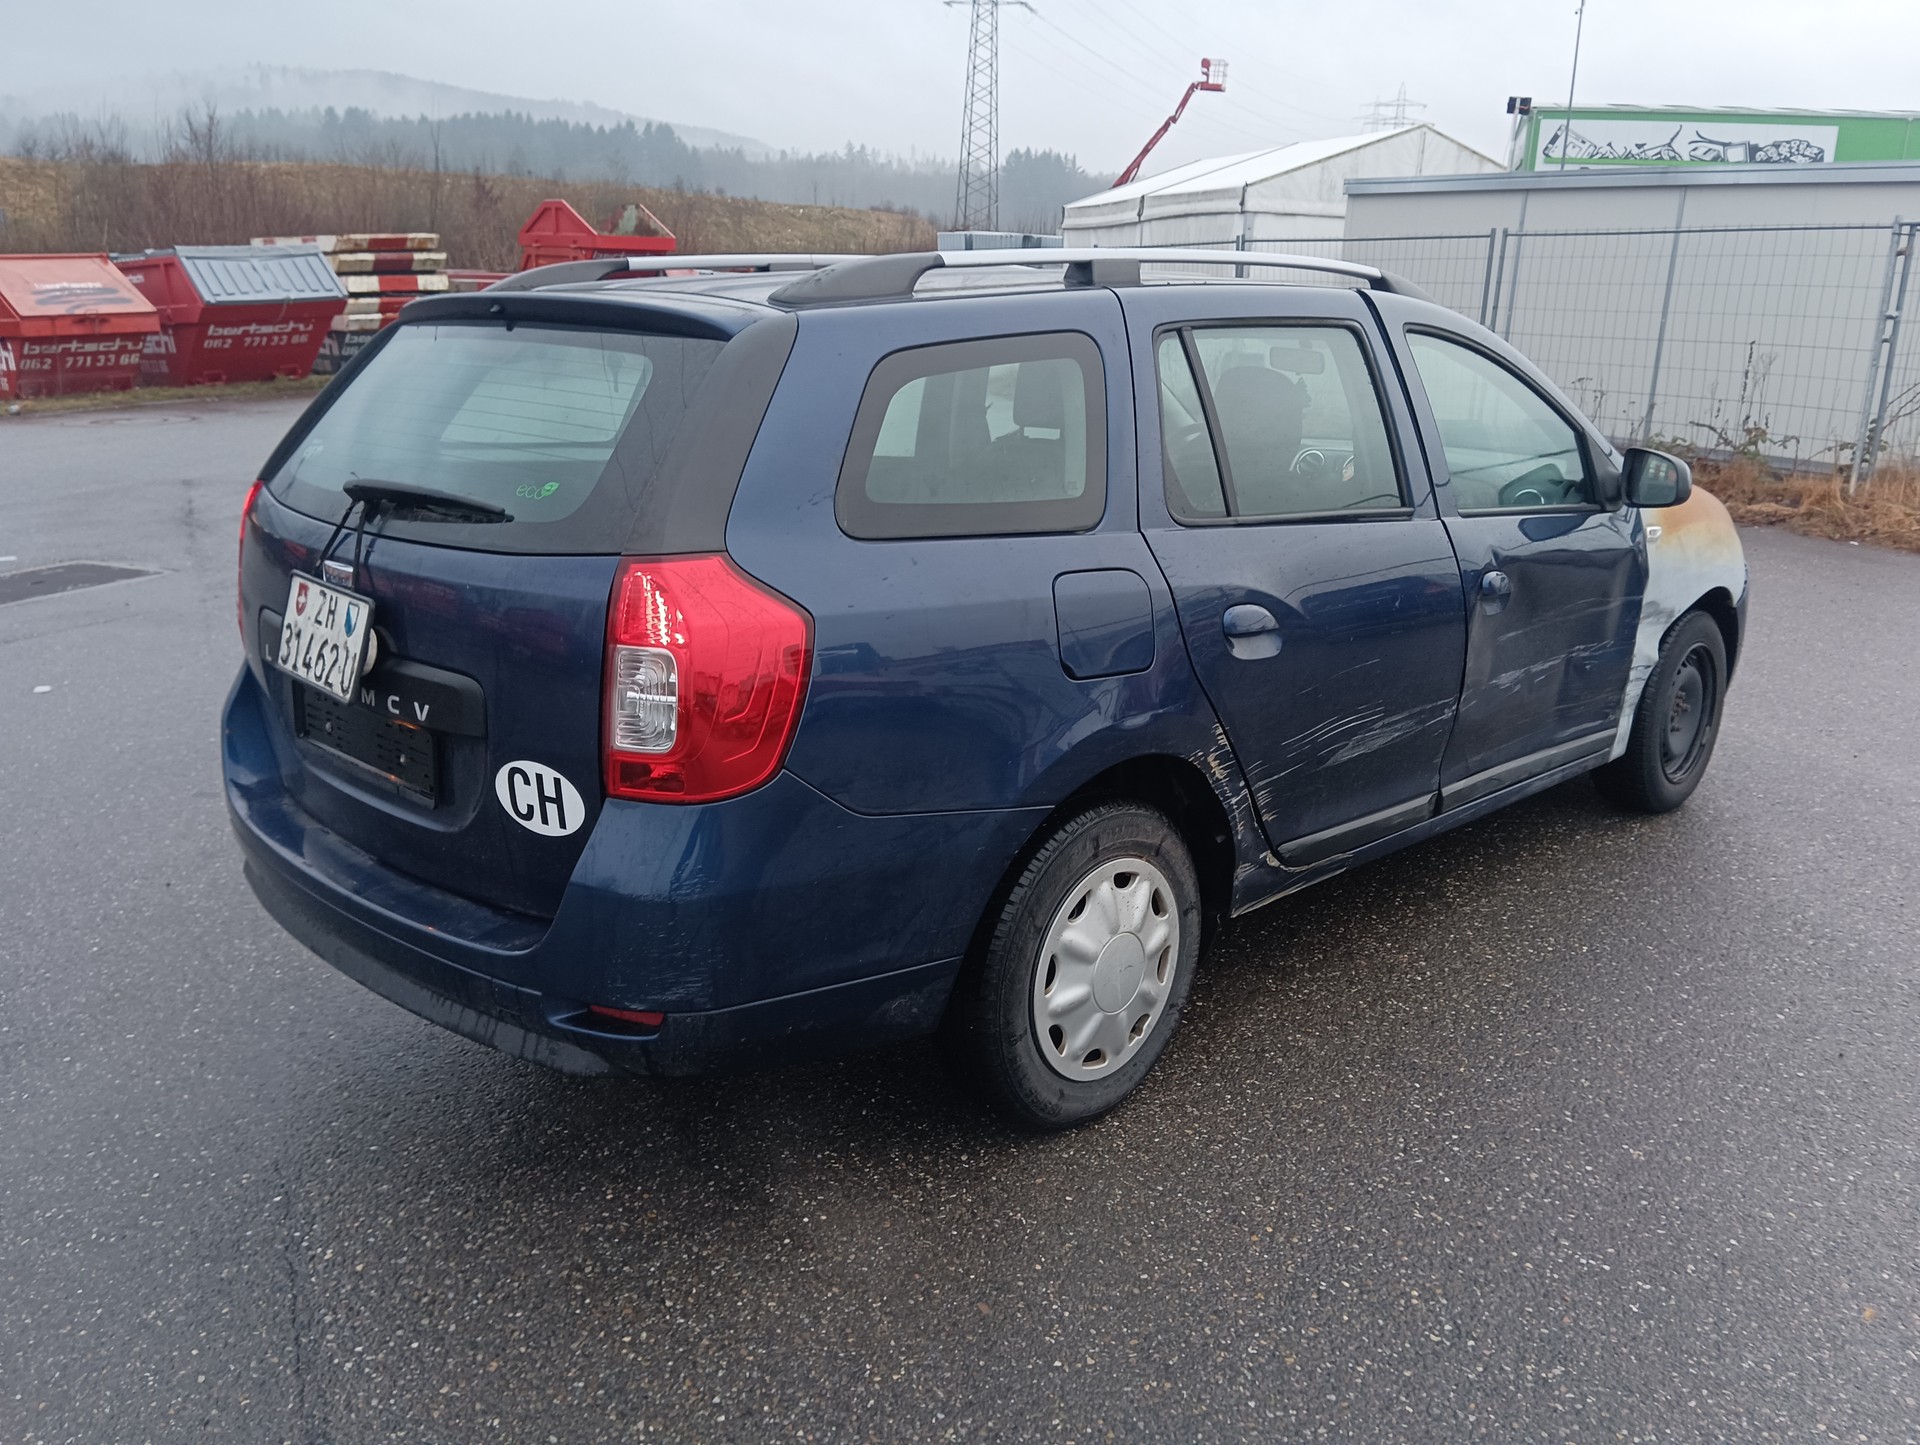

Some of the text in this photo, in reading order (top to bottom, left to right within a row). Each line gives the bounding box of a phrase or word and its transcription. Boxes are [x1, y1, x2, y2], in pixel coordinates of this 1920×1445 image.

[207, 319, 314, 336] bertschi
[23, 337, 144, 355] bertschi
[204, 333, 309, 349] 062 771 33 66
[20, 353, 141, 370] 062 771 33 66
[313, 589, 339, 631] ZH
[507, 766, 568, 831] CH
